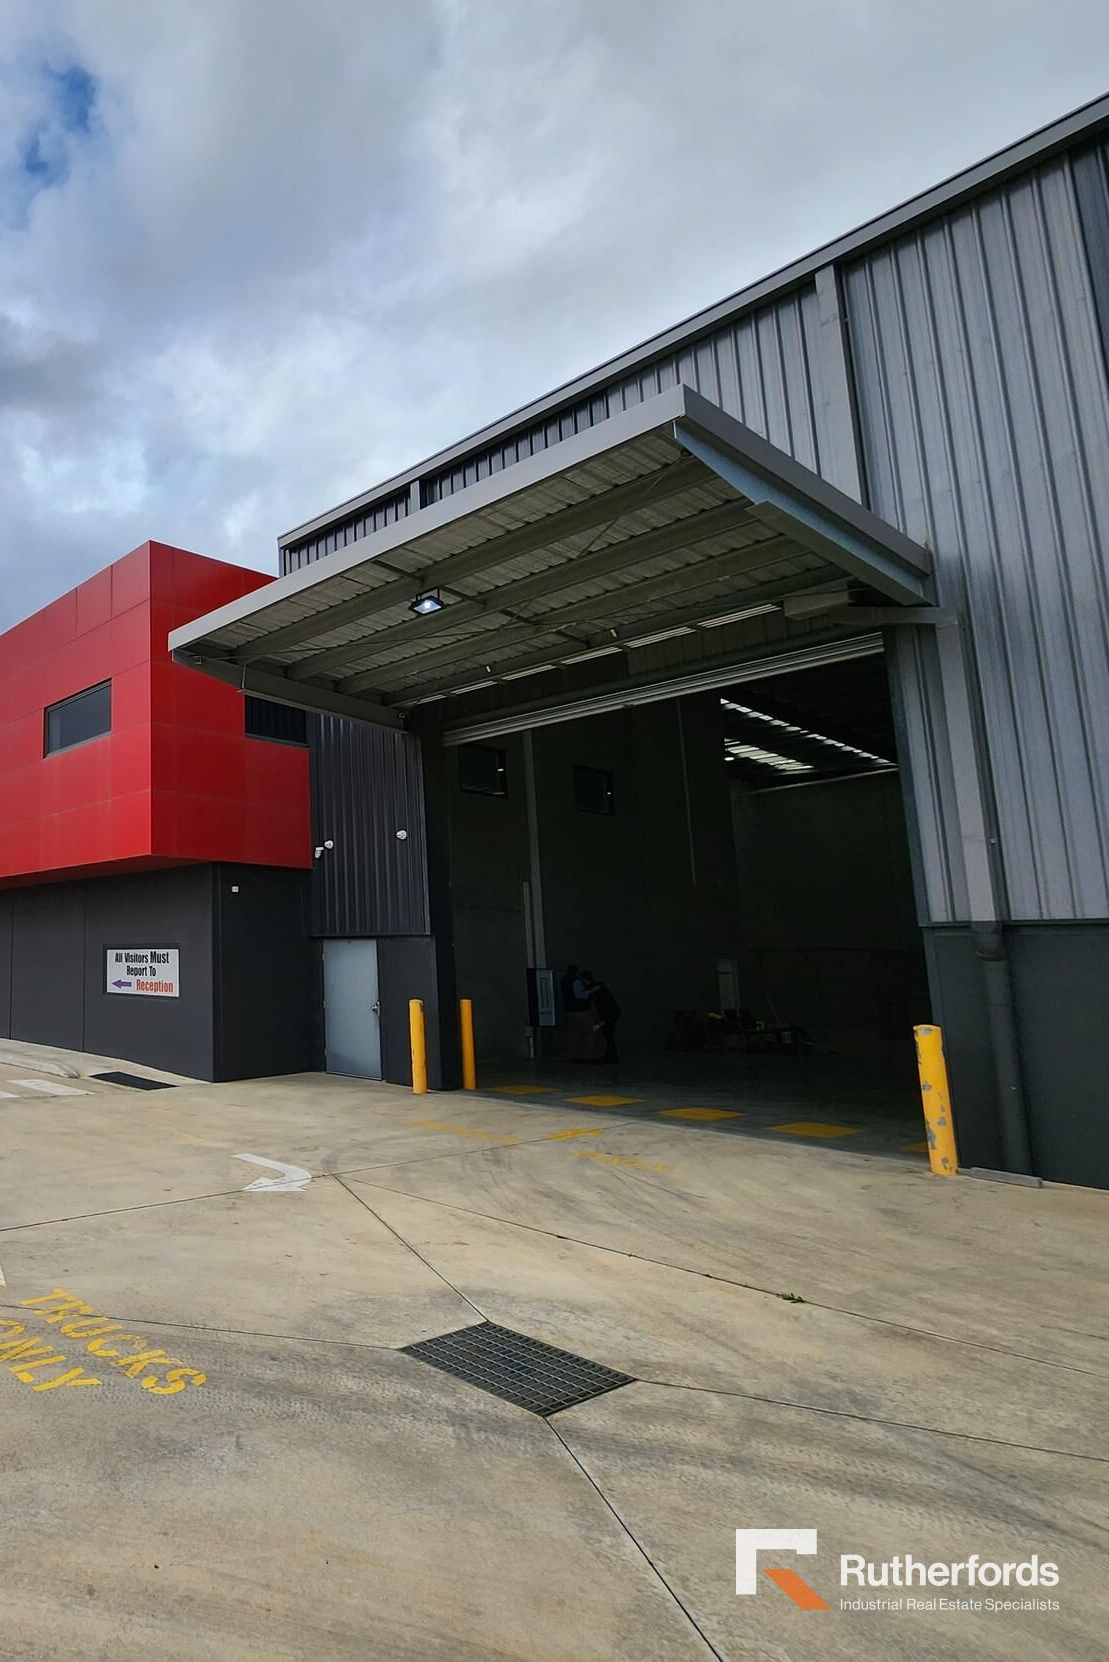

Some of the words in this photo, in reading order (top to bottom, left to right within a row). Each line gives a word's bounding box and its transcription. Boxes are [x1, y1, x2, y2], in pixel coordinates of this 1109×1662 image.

[115, 952, 123, 962] All
[124, 952, 149, 964] Visitors
[150, 951, 170, 964] Must
[126, 965, 147, 977] Report
[149, 966, 157, 977] To
[136, 979, 174, 993] Reception
[20, 1288, 208, 1396] TRUCKS
